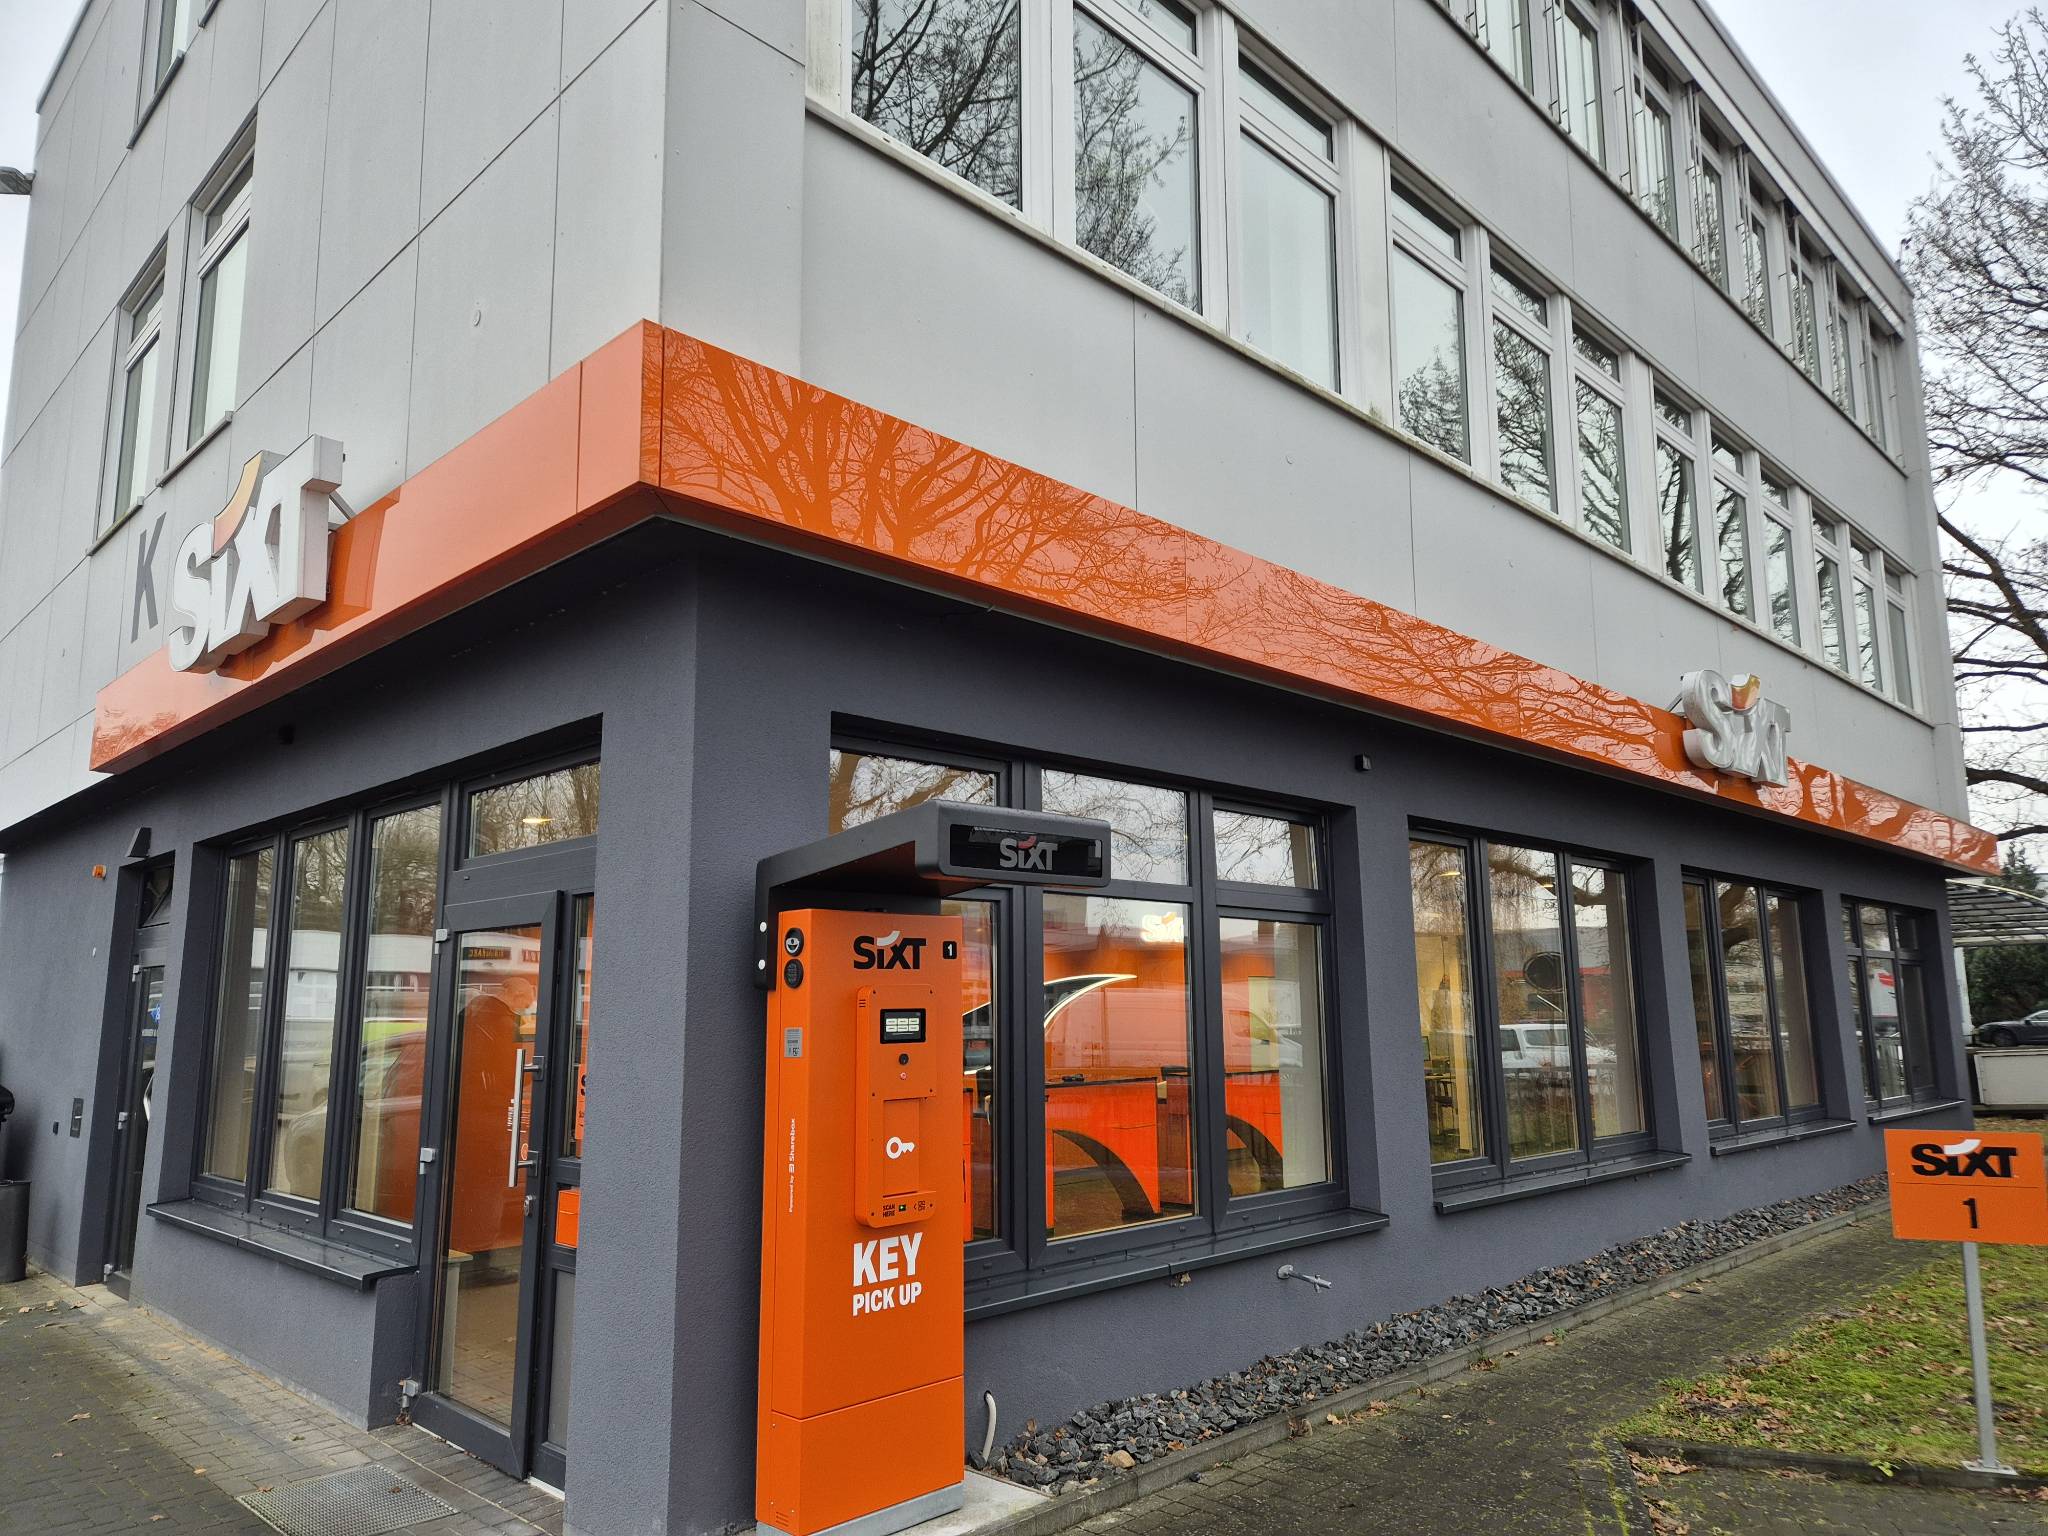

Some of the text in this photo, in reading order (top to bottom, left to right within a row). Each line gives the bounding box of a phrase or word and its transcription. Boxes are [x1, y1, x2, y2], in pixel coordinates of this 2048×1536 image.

[169, 433, 343, 674] SIXT
[1682, 669, 1791, 788] SIXT
[999, 835, 1058, 871] SIXT
[853, 930, 927, 970] SIXT
[788, 1118, 796, 1162] Sharebox
[1911, 1138, 2018, 1178] SIXT
[882, 1202, 896, 1211] SCAN
[882, 1210, 896, 1218] HERE
[1962, 1197, 1979, 1229] 1
[852, 1232, 923, 1287] KEY
[852, 1281, 922, 1316] PICK UP
